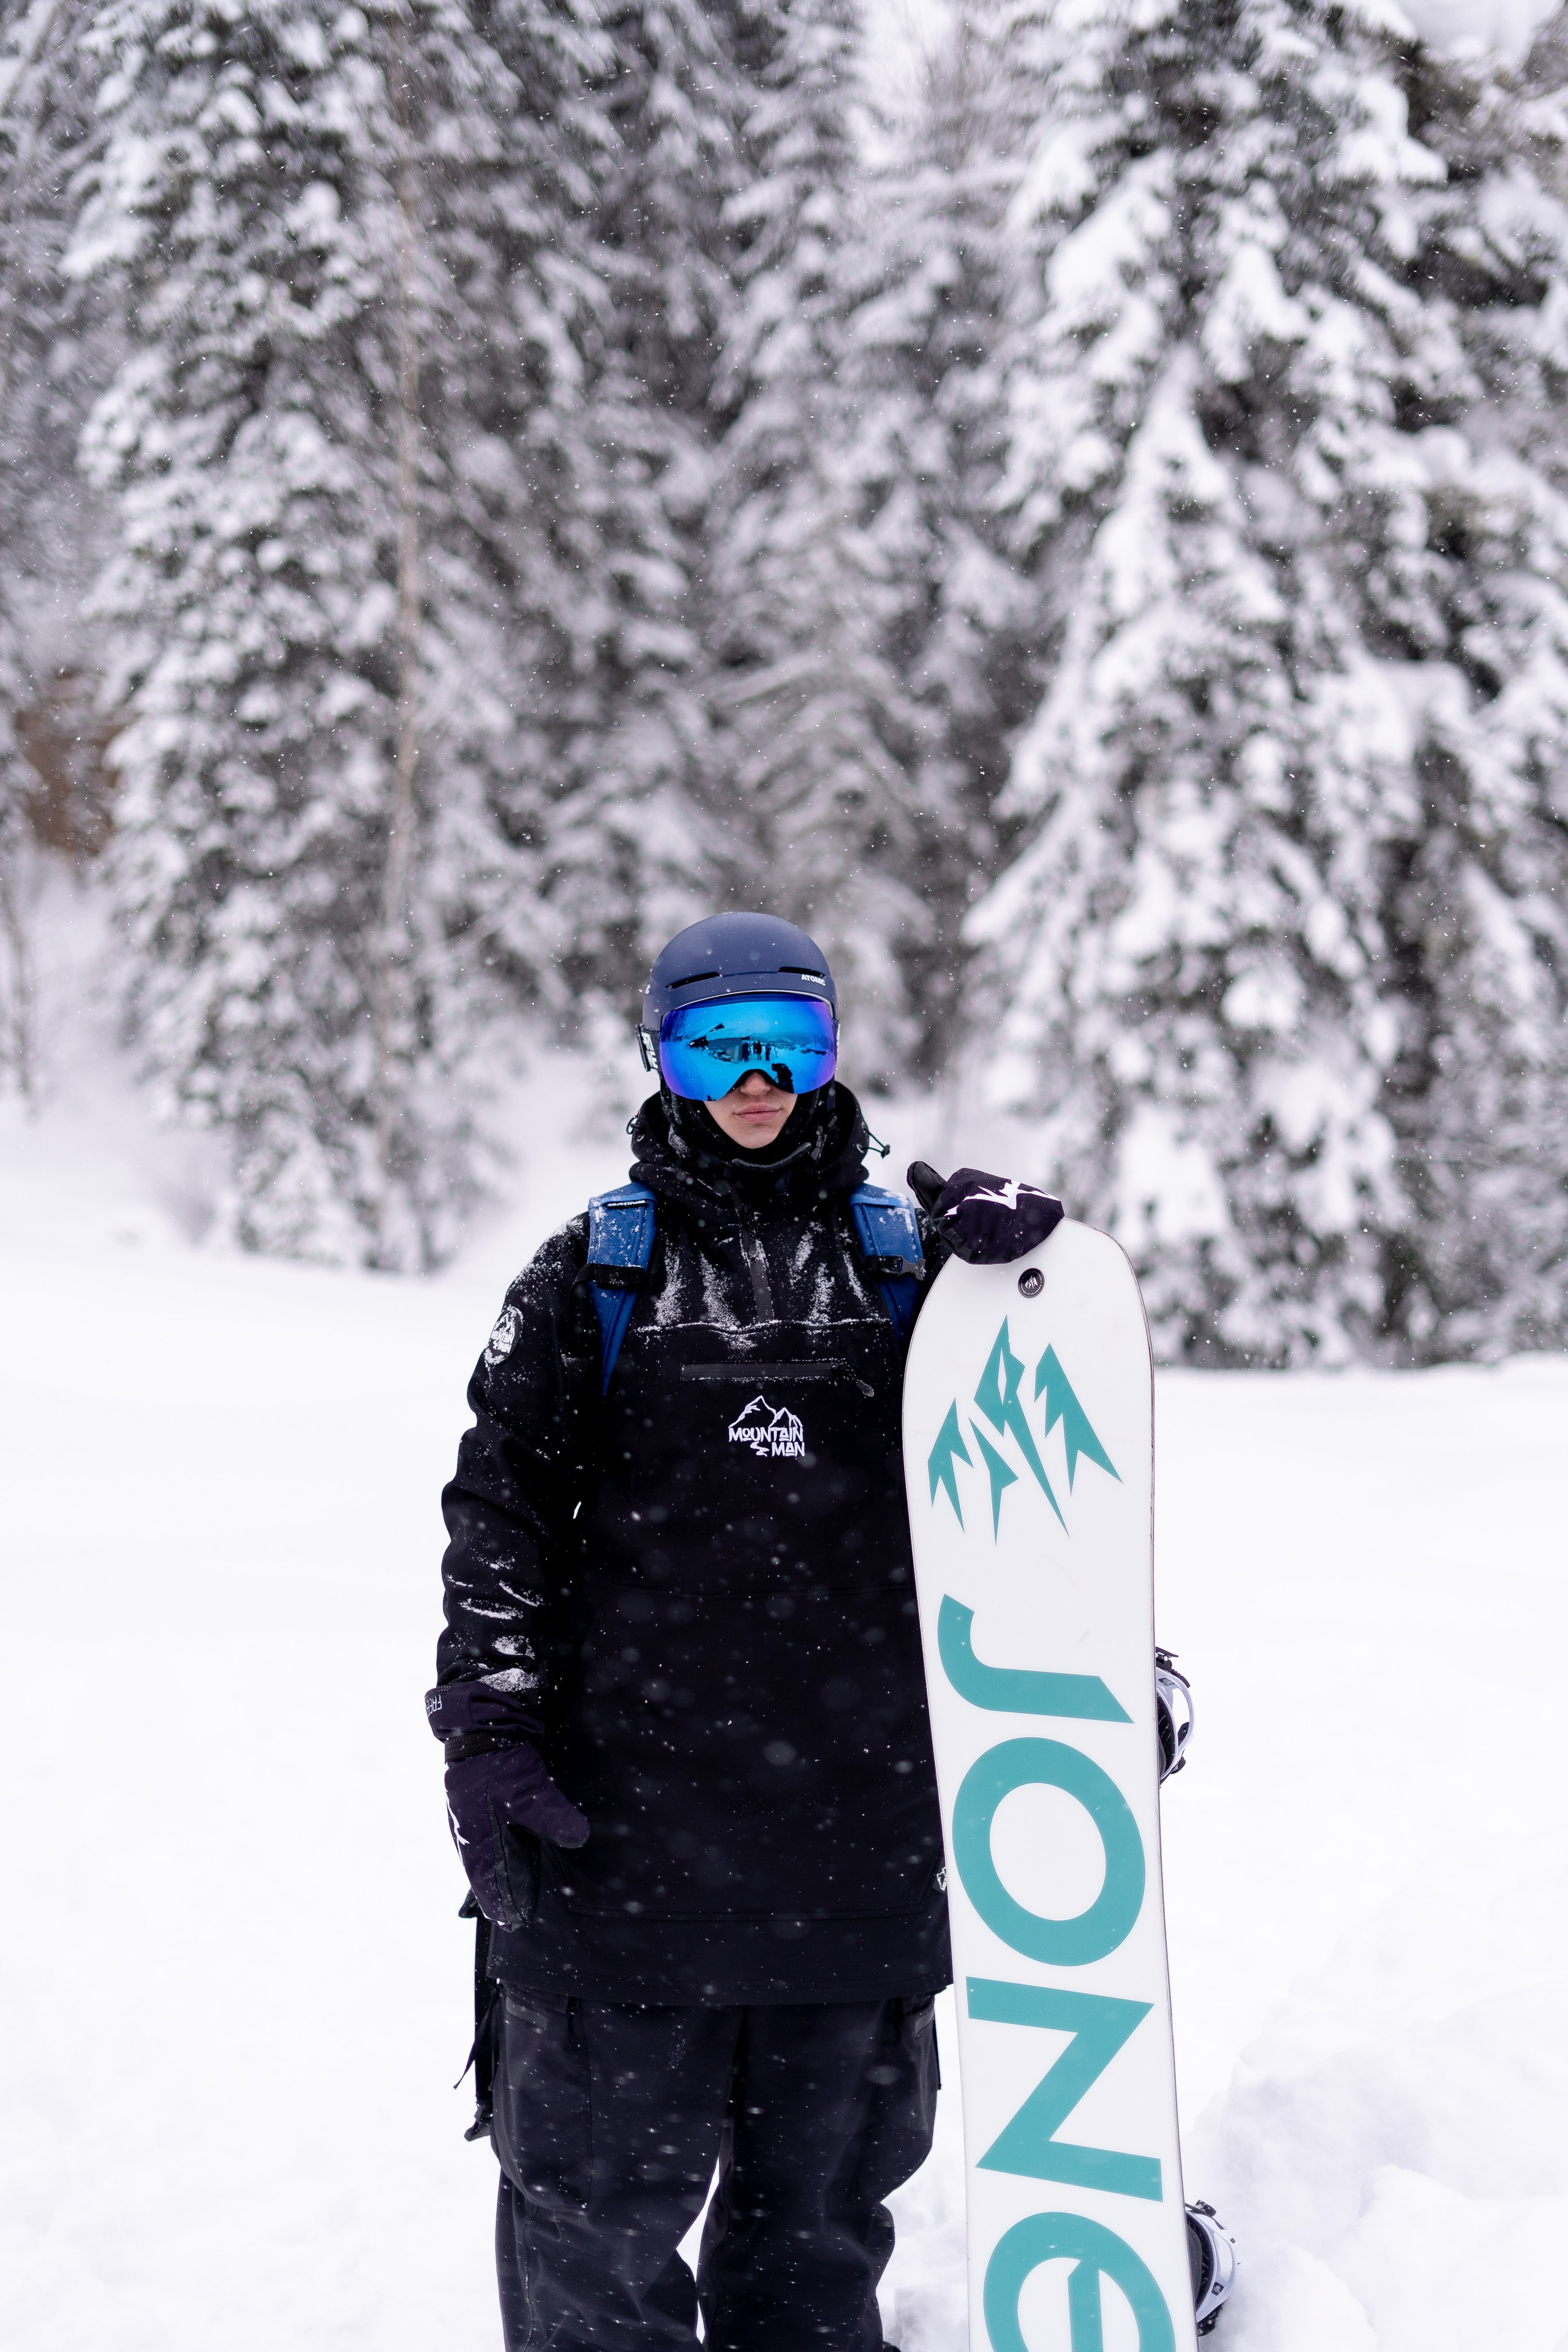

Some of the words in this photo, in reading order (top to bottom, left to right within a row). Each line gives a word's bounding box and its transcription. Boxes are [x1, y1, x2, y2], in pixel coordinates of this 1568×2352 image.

[801, 974, 826, 987] ATOMIC
[728, 1427, 804, 1442] MOUNTAIN
[771, 1441, 805, 1457] MAN
